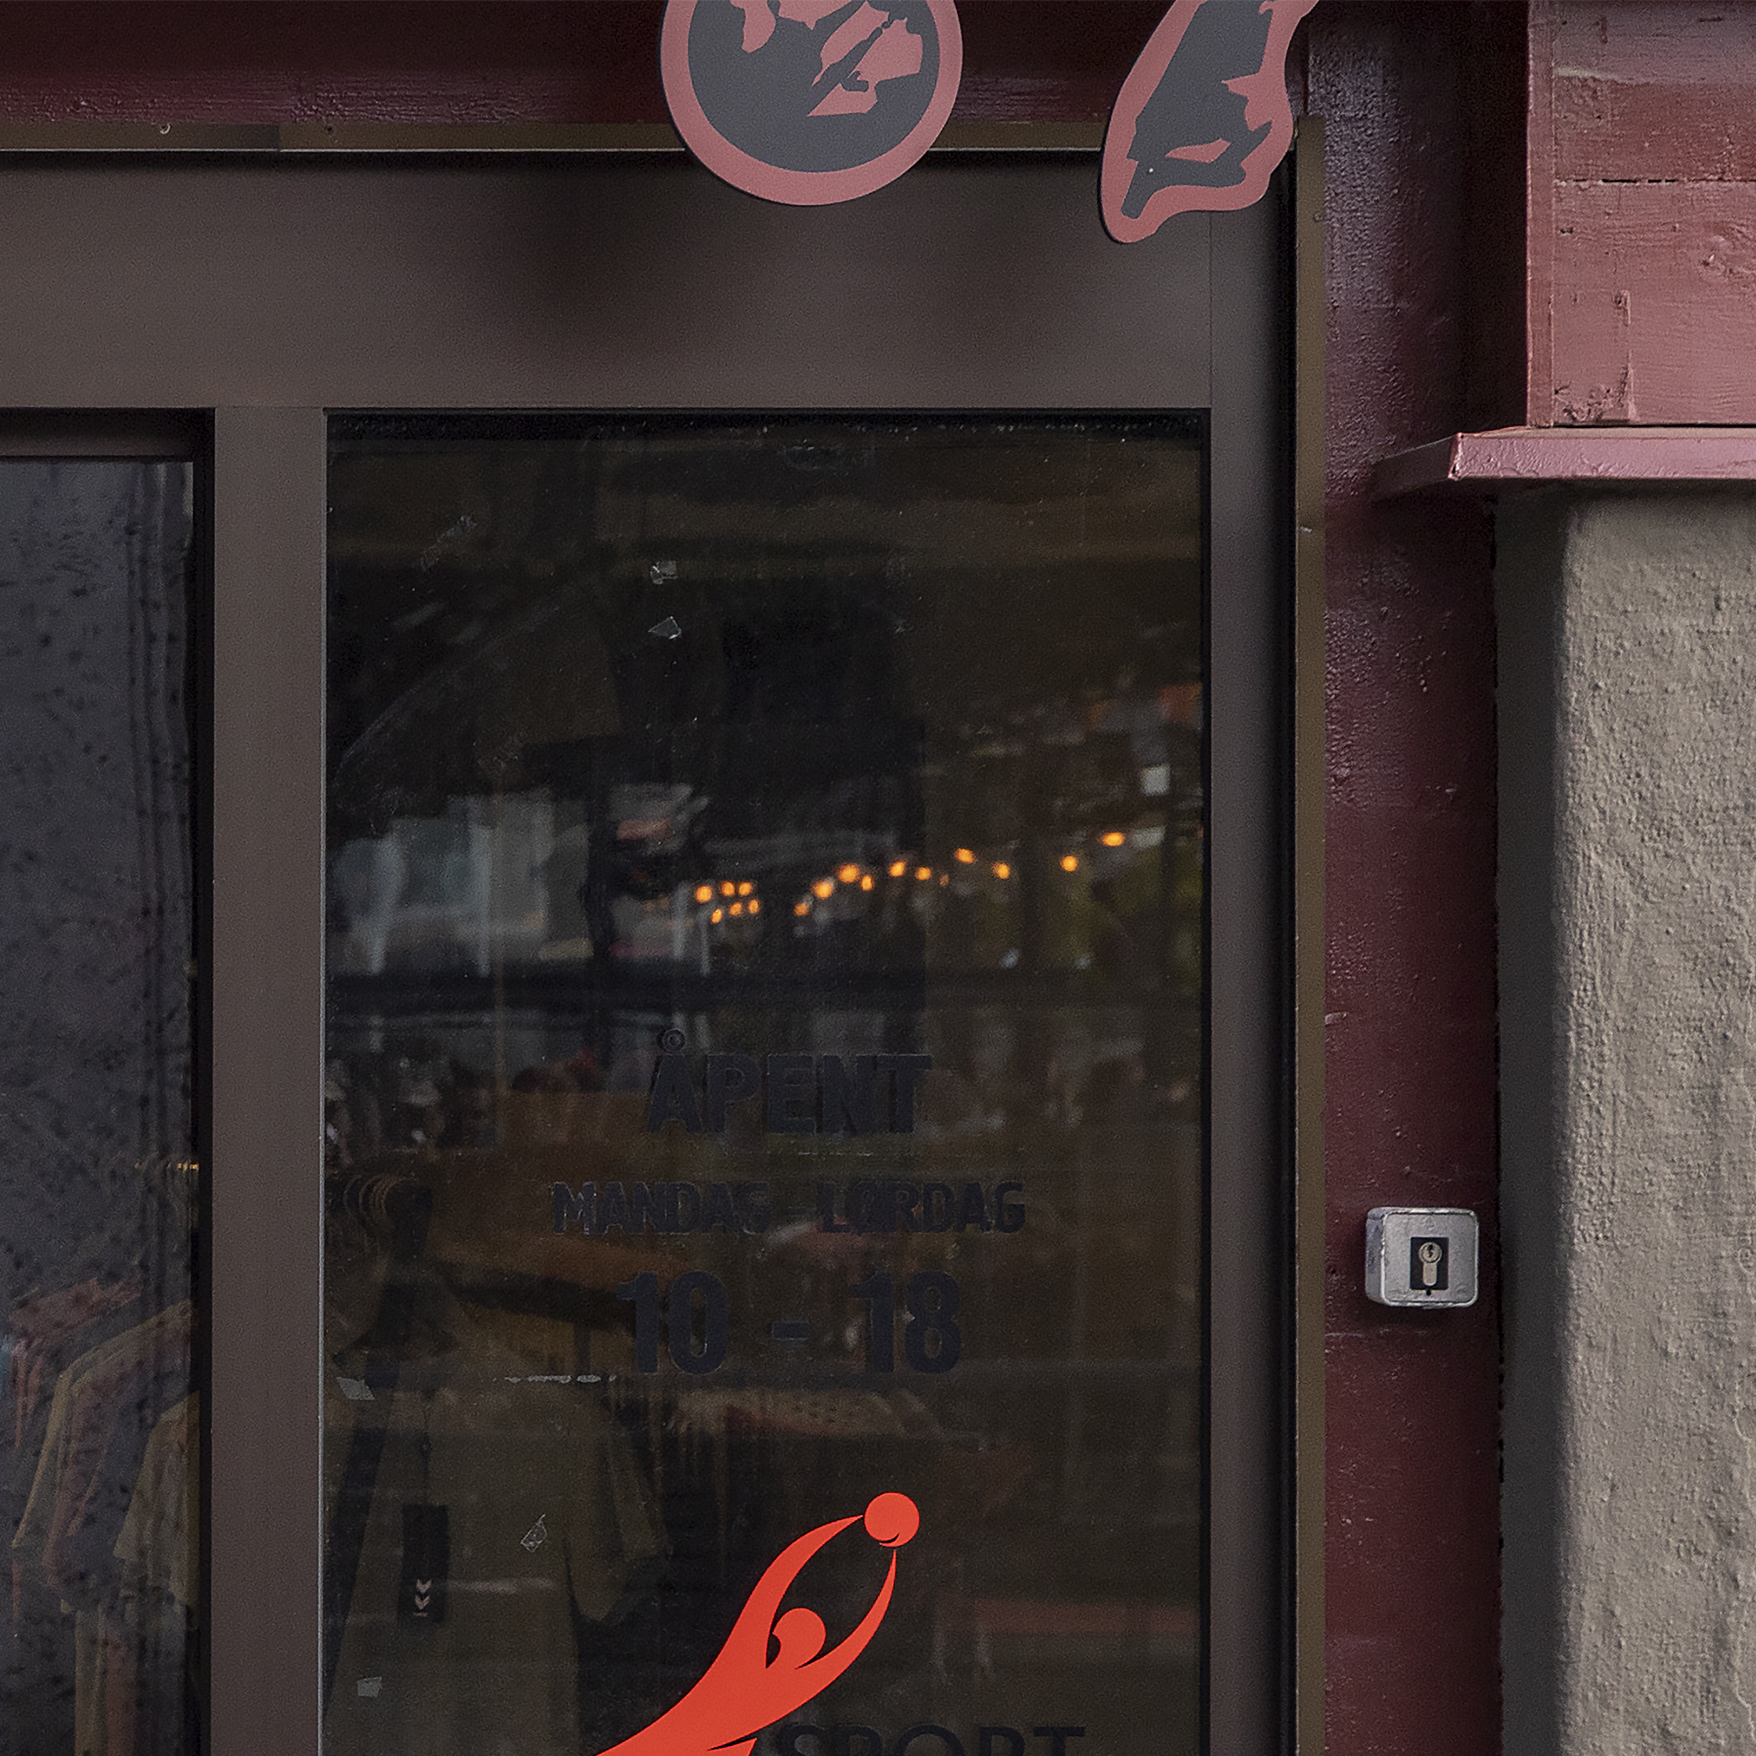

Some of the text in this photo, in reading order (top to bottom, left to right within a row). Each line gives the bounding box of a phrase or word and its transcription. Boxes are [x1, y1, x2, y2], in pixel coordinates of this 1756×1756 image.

[646, 1028, 933, 1134] ÅPENT
[552, 1180, 771, 1236] MANDAG
[818, 1179, 1027, 1234] LØRDAG
[616, 1271, 730, 1375] 10
[849, 1271, 963, 1374] 18
